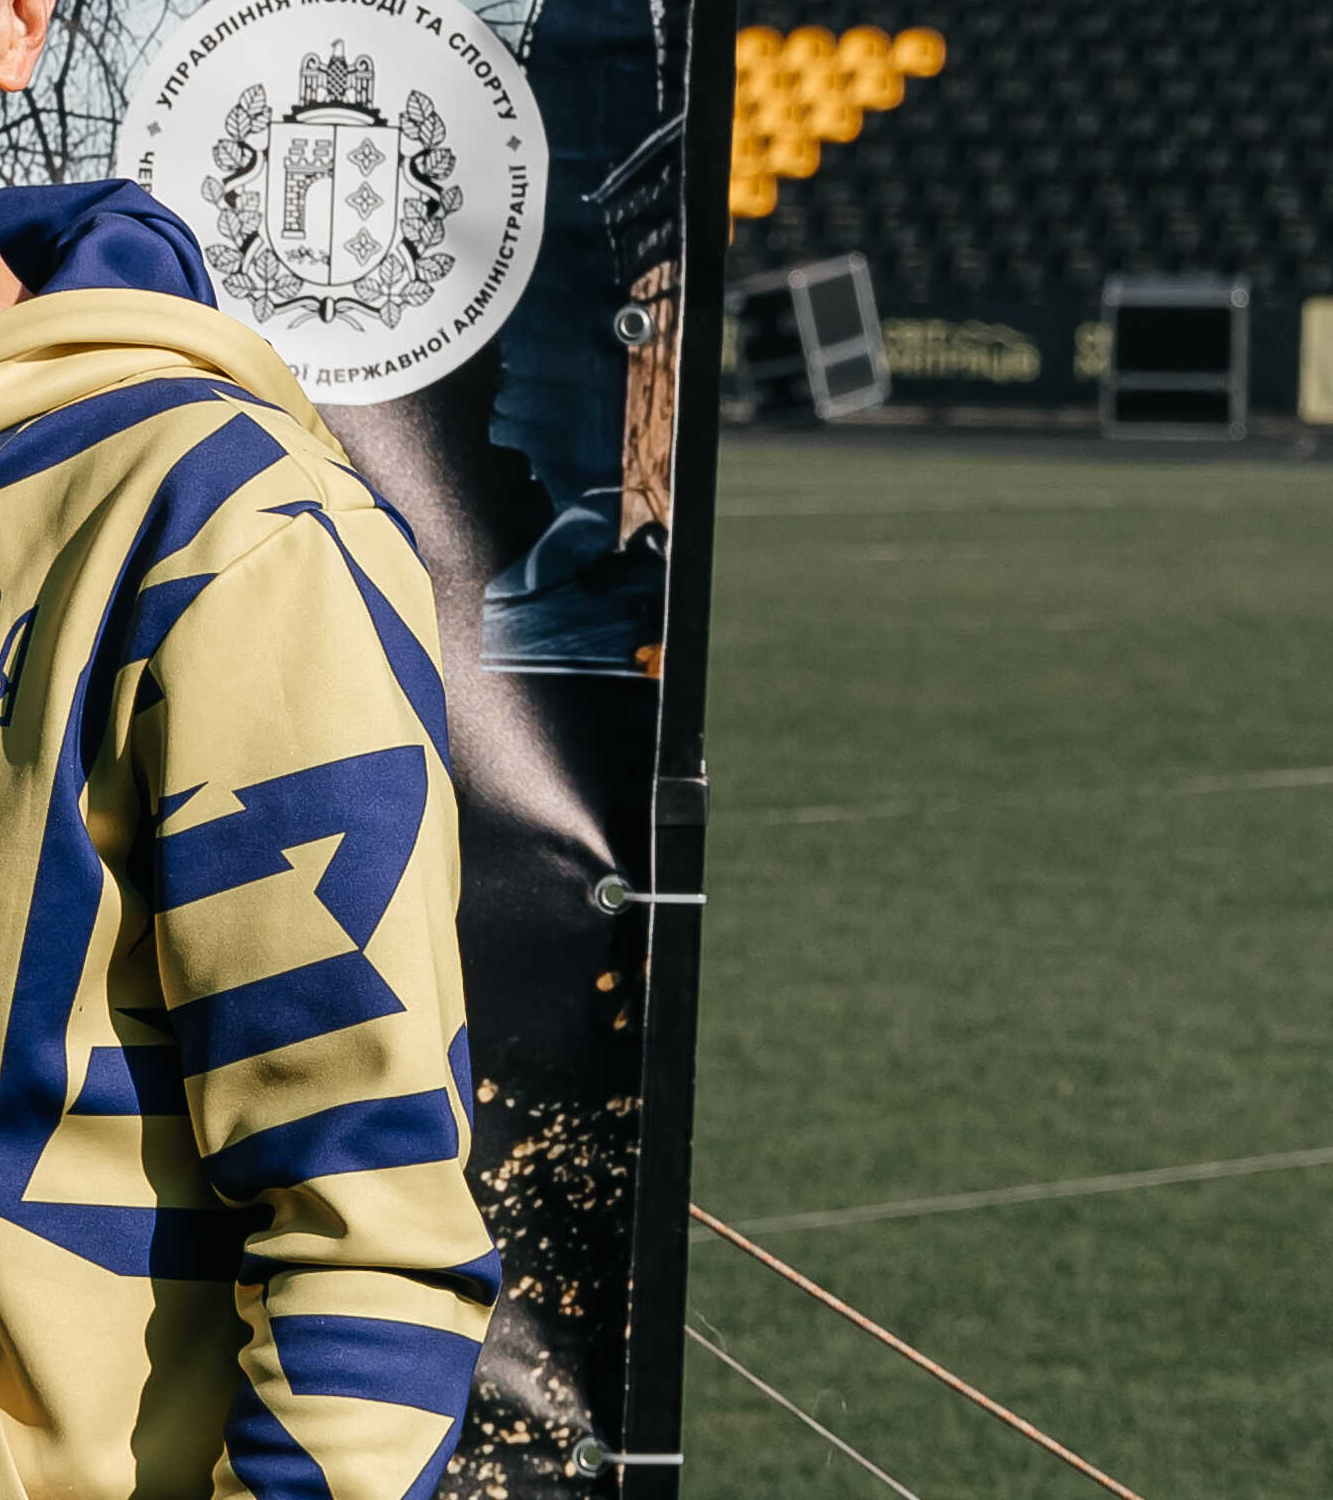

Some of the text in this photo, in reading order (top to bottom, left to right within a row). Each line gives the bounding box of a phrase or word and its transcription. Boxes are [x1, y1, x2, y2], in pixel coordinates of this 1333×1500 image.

[416, 5, 442, 37] ТА
[448, 32, 518, 122] СПОРТУ
[315, 328, 452, 387] ДЕРЖАВНОЇ
[454, 163, 529, 336] АДМІНІСТРАЦІЇ
